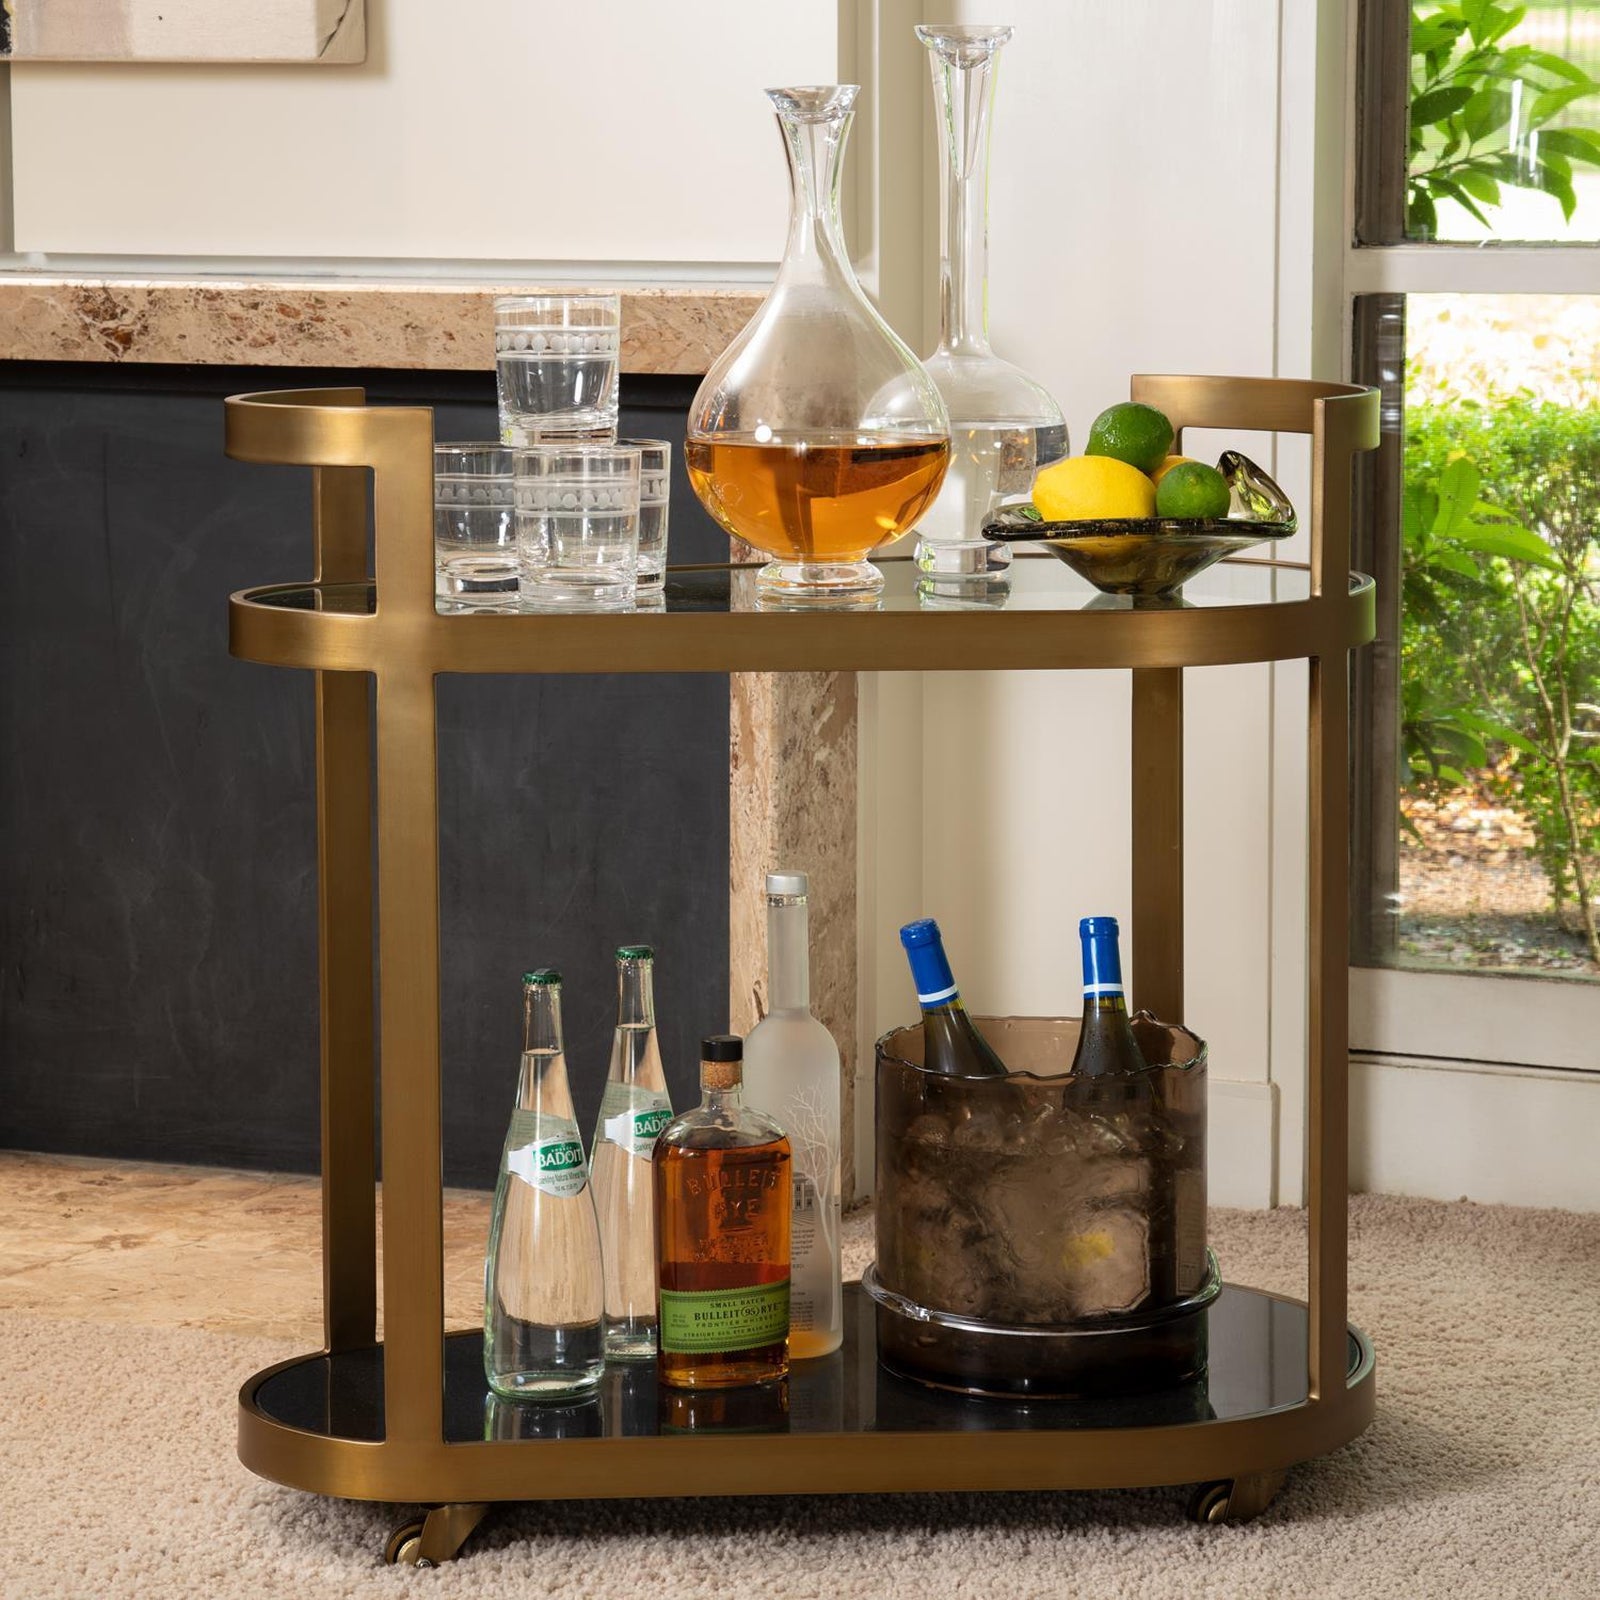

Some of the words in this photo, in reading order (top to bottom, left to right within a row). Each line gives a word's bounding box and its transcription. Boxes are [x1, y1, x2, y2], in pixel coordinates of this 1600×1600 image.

[635, 1117, 676, 1136] BADO
[538, 1148, 582, 1167] BADOIT
[687, 1168, 781, 1195] BULLEIT
[714, 1198, 761, 1219] RYE
[694, 1309, 740, 1321] BULLEIT
[761, 1303, 779, 1314] RYE
[710, 1301, 737, 1309] SMALL
[740, 1296, 766, 1306] BATCH
[696, 1319, 740, 1329] FRONTIER
